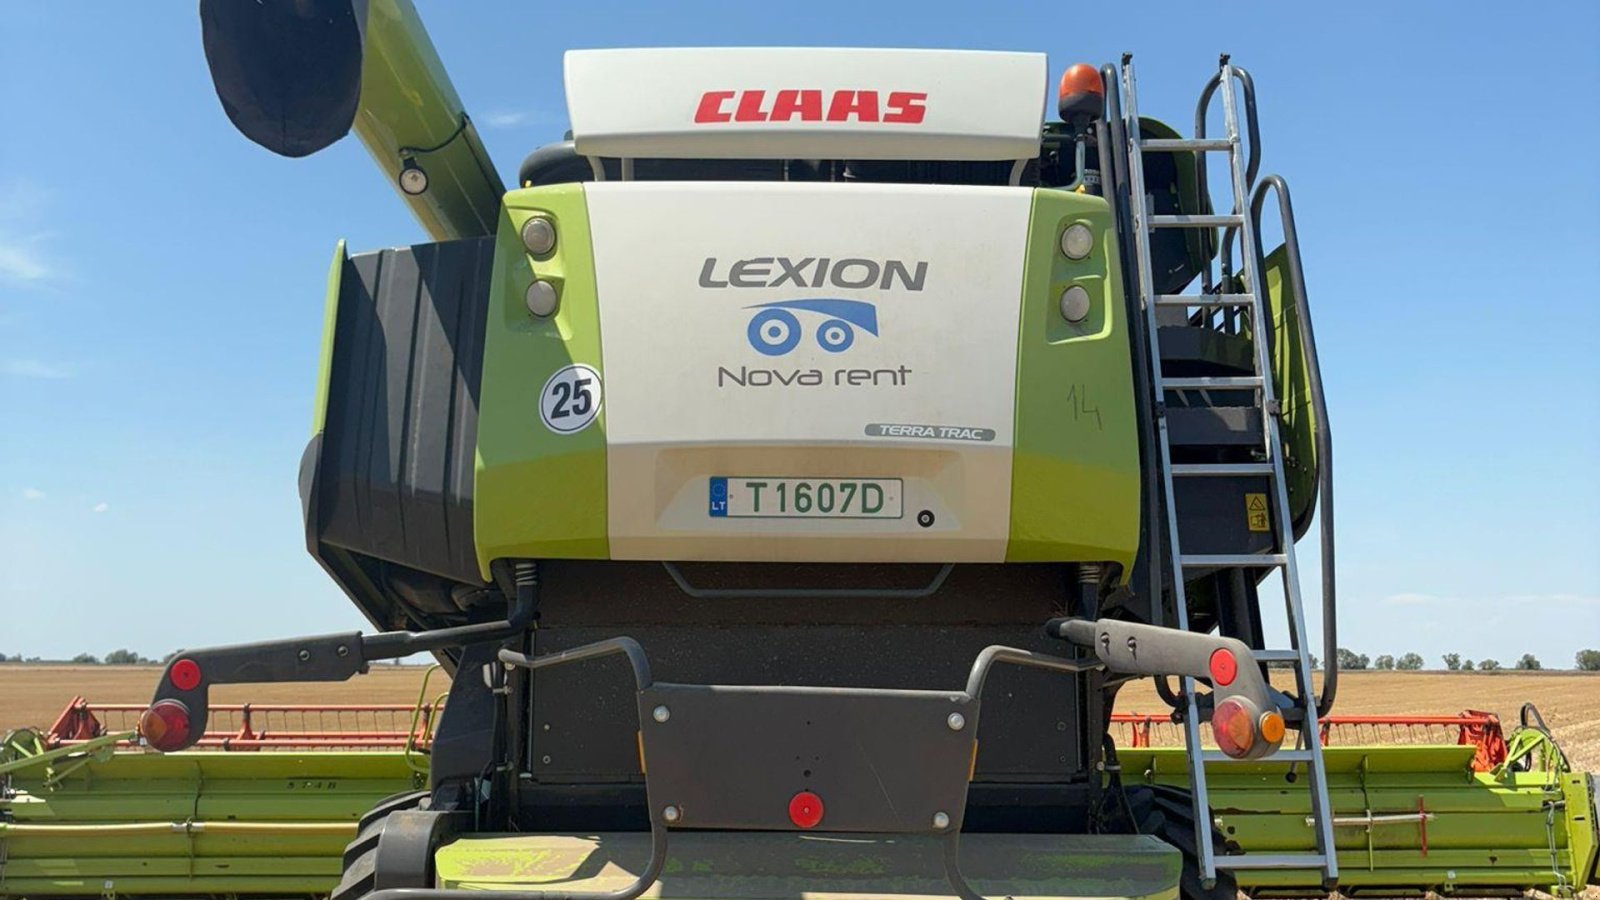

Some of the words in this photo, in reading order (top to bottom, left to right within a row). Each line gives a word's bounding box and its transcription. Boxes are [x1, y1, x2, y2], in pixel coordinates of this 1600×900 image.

[694, 90, 928, 124] CLAAS
[699, 257, 928, 291] LEXION
[718, 366, 823, 387] Nova
[834, 365, 912, 386] rent
[551, 378, 592, 419] 25
[1066, 383, 1103, 431] 14
[880, 425, 935, 437] TERRA
[939, 427, 983, 439] TRAC
[711, 501, 726, 511] LT
[745, 482, 884, 513] T1607D
